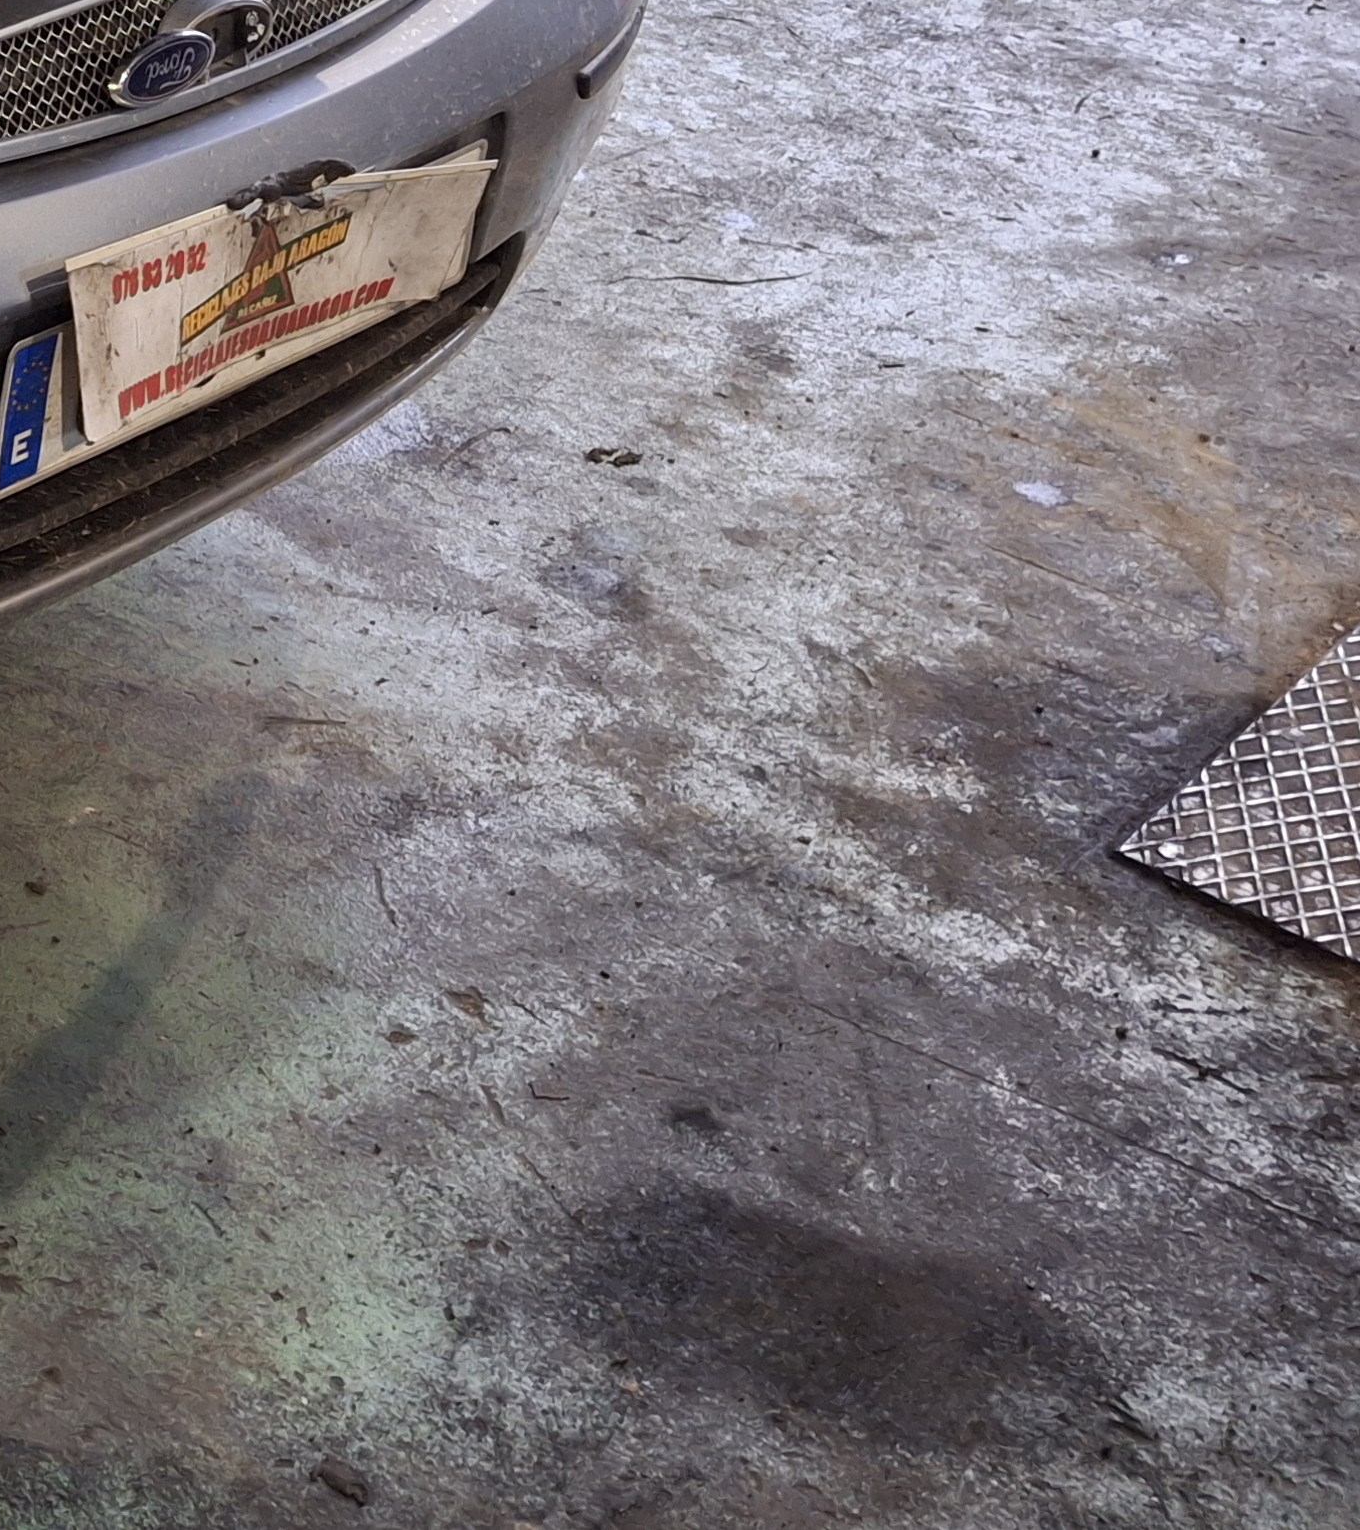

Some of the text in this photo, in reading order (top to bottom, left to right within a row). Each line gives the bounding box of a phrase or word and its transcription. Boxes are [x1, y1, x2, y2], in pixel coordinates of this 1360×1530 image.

[145, 47, 196, 90] Ford
[142, 258, 163, 292] 83
[165, 250, 185, 284] 20
[187, 241, 208, 275] 52
[182, 221, 349, 340] RECICLAJES BAJO ARAGÓN
[117, 276, 396, 420] WWW.RECICLAJESBAJOARAGON.COM
[10, 428, 32, 466] E
